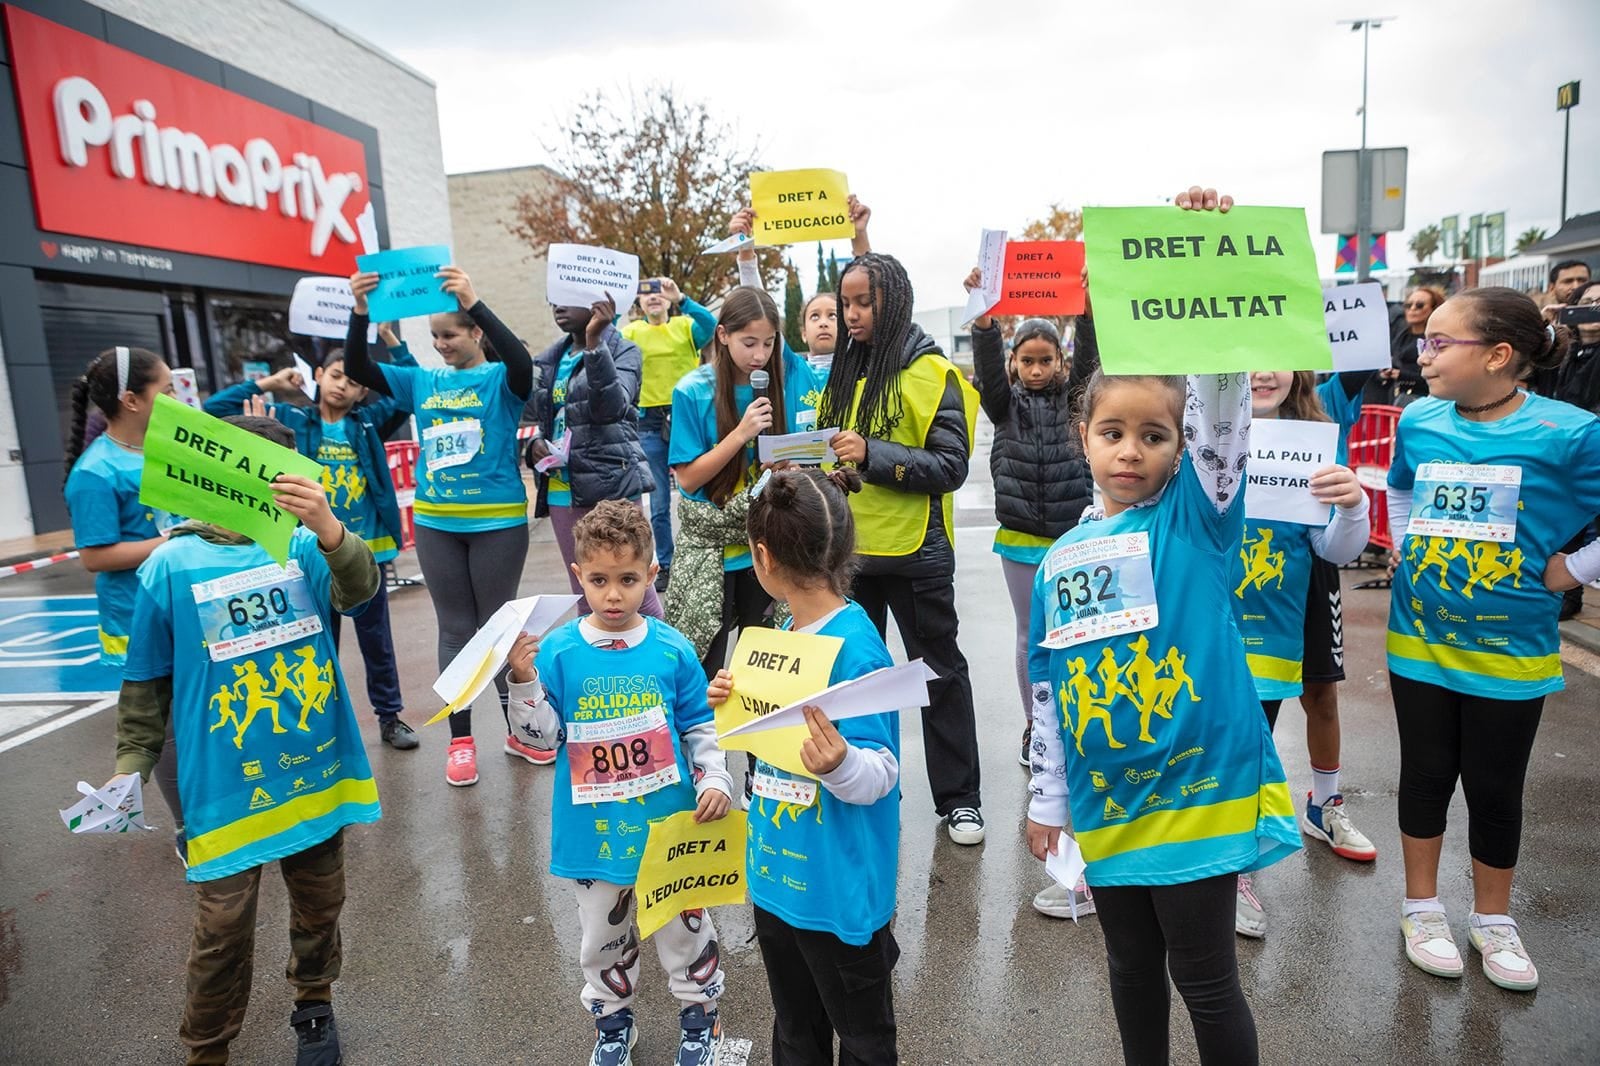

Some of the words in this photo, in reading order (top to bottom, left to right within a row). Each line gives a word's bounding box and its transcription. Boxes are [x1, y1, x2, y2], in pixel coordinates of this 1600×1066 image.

[778, 191, 814, 203] DRET
[818, 190, 828, 200] A
[764, 212, 845, 231] L'EDUCACIÓ
[1016, 253, 1043, 261] DRET
[1047, 253, 1054, 261] A
[1122, 235, 1206, 260] DRET
[1216, 235, 1239, 257] A
[1246, 235, 1284, 256] LA
[101, 247, 117, 263] in
[119, 249, 173, 271] Terrassa
[577, 254, 597, 263] DRET
[559, 274, 628, 290] L'ABANDONAMENT
[603, 269, 632, 281] CONTRA
[1007, 271, 1061, 280] L'ATENCIÓ
[396, 290, 407, 298] EL
[410, 287, 429, 297] JOC
[1008, 290, 1058, 299] ESPECIAL
[1131, 295, 1287, 320] IGUALTAT
[1325, 301, 1337, 313] A
[1342, 298, 1366, 310] LA
[174, 426, 233, 463] DRET
[235, 456, 252, 474] A
[436, 433, 465, 453] 634
[1257, 449, 1276, 460] LA
[1281, 451, 1312, 463] PAU
[1317, 453, 1322, 463] I
[1247, 474, 1310, 488] NESTAR
[166, 463, 282, 524] LLIBERTAT
[1433, 484, 1487, 514] 635
[1056, 565, 1116, 611] 632
[228, 587, 288, 627] 630
[747, 650, 788, 671] DRET
[788, 657, 801, 675] A
[583, 675, 660, 696] CURSA
[577, 692, 665, 710] SOLIDARIA
[740, 695, 782, 716] L'AMO
[574, 711, 593, 721] PER
[595, 710, 603, 719] A
[605, 709, 622, 719] LA
[592, 738, 649, 774] 808
[667, 840, 711, 862] DRET
[713, 839, 727, 852] A
[645, 870, 739, 909] L'EDUCACIÓ
